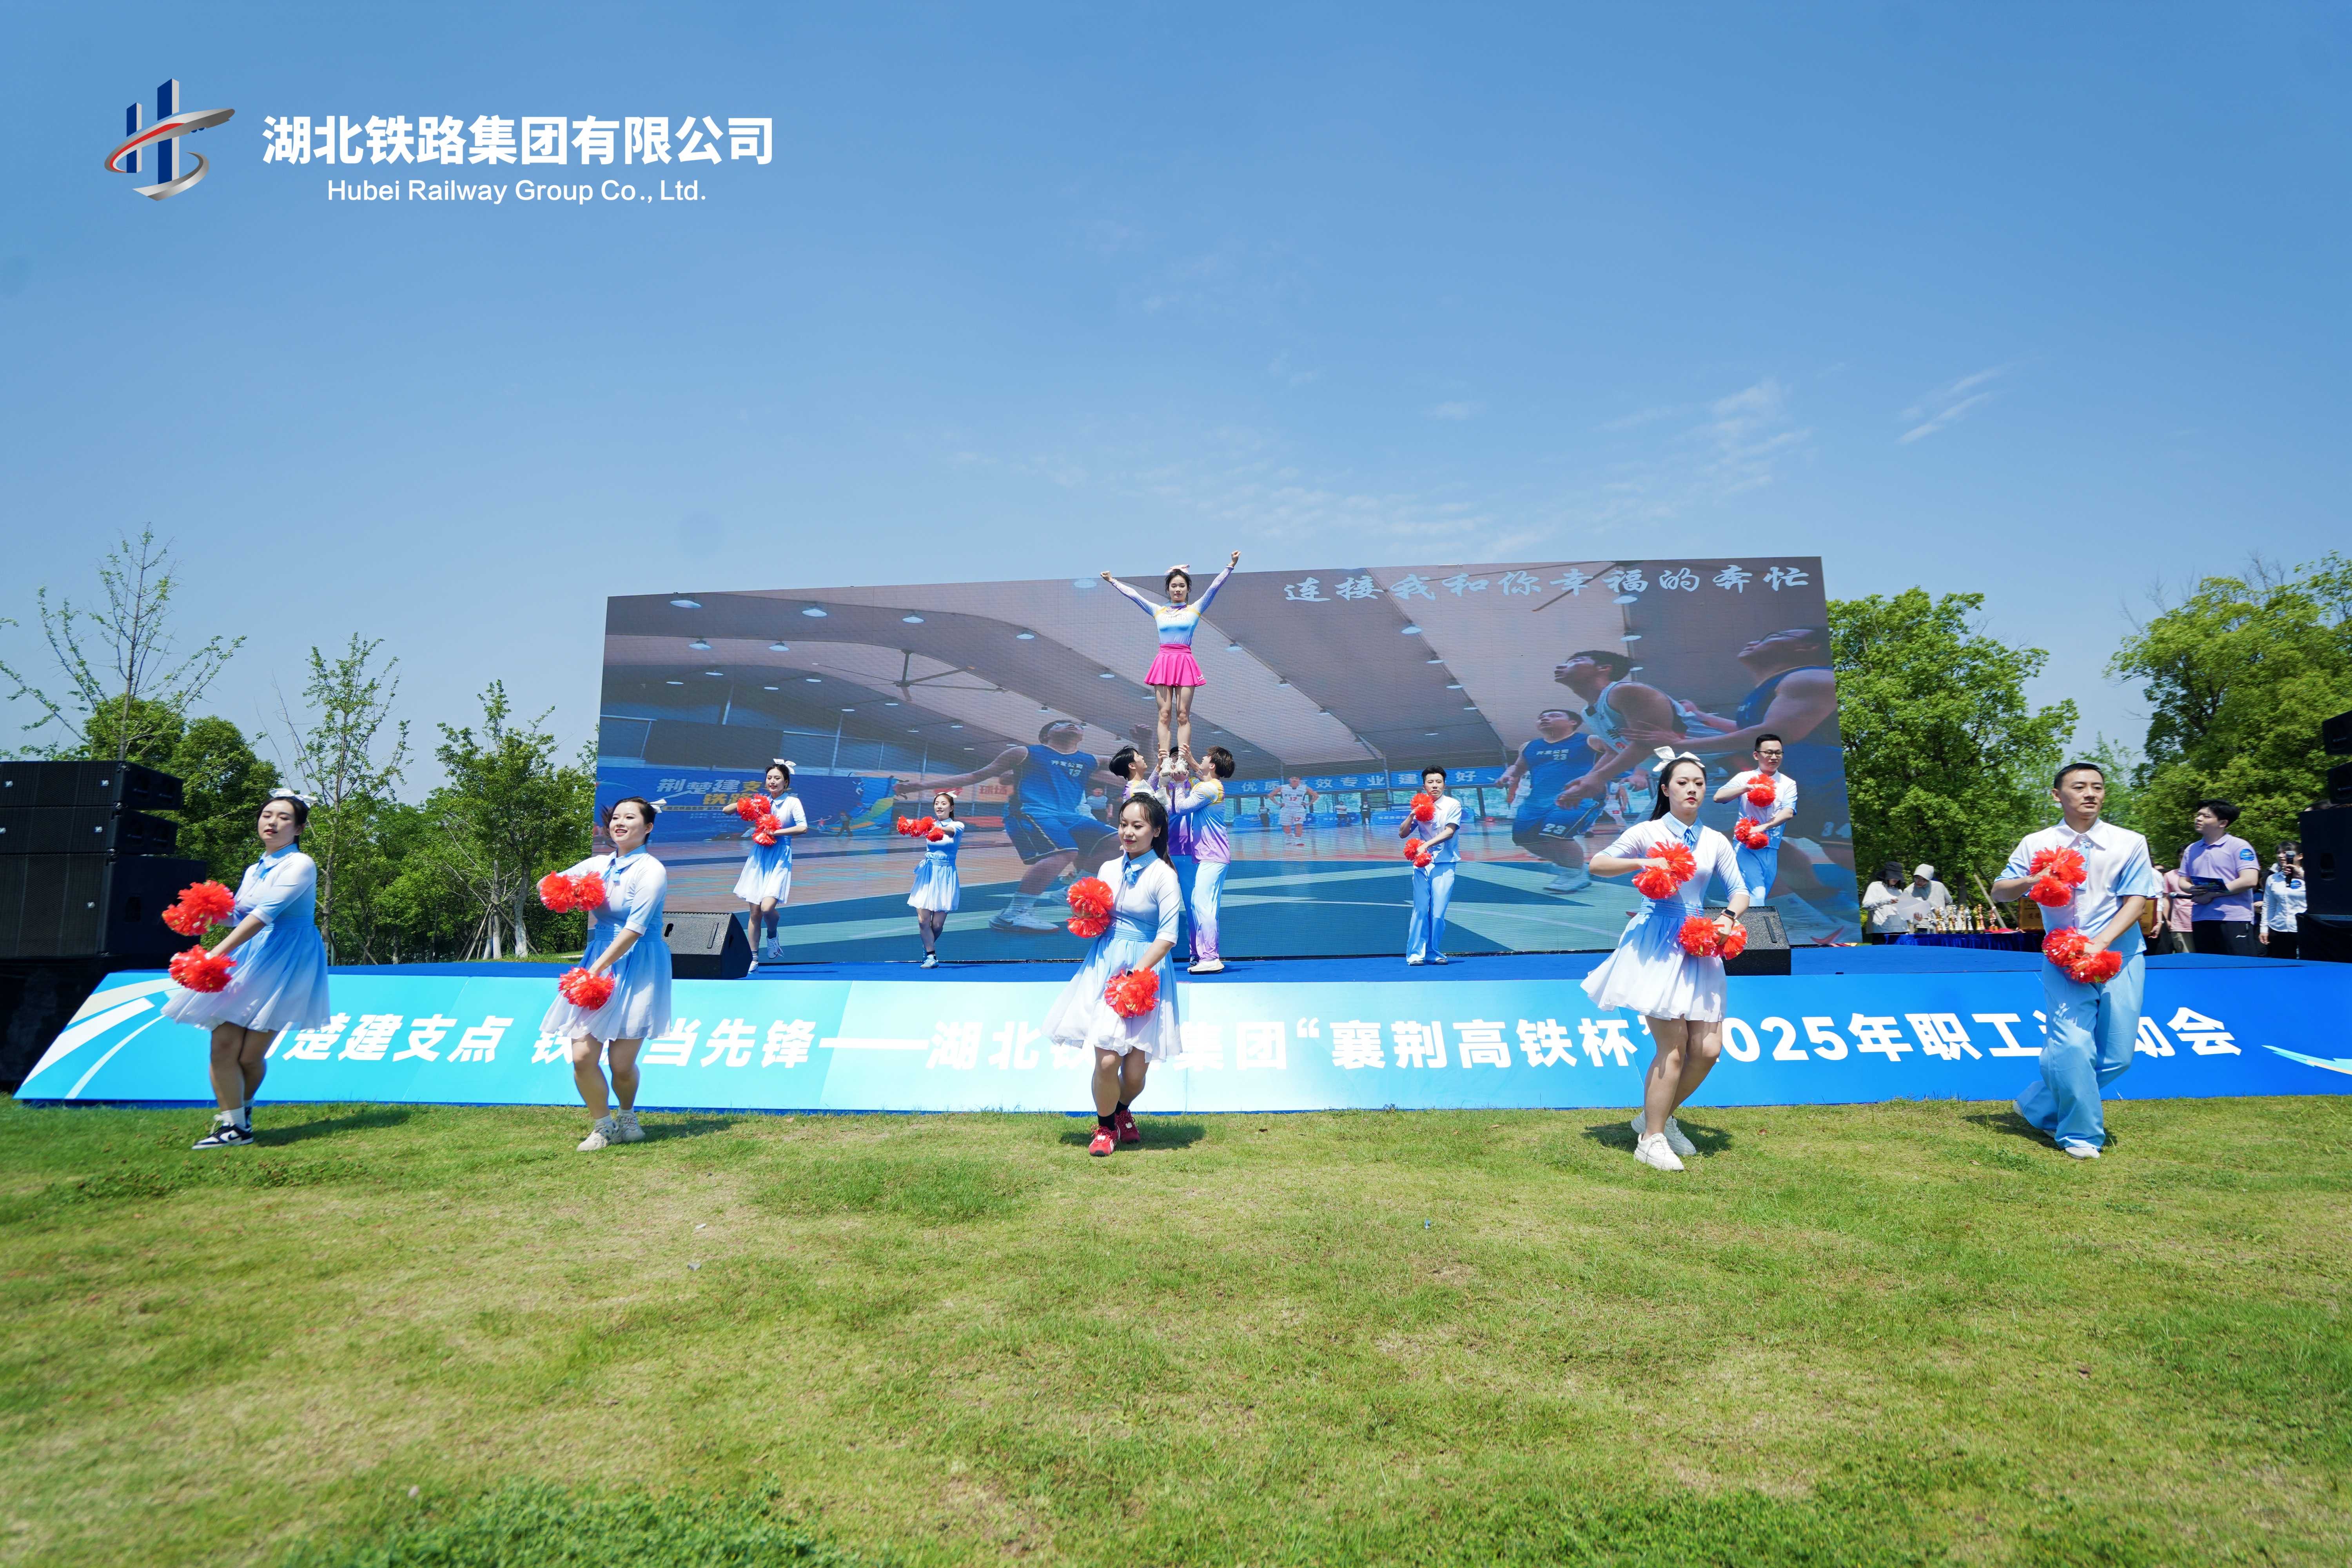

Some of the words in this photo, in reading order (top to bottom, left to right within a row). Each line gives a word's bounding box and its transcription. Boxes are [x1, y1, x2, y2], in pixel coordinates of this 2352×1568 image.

[1284, 564, 1809, 602] 连接我和你幸福的奔忙
[1543, 823, 1566, 835] 23
[265, 1012, 514, 1063] 楚建支点
